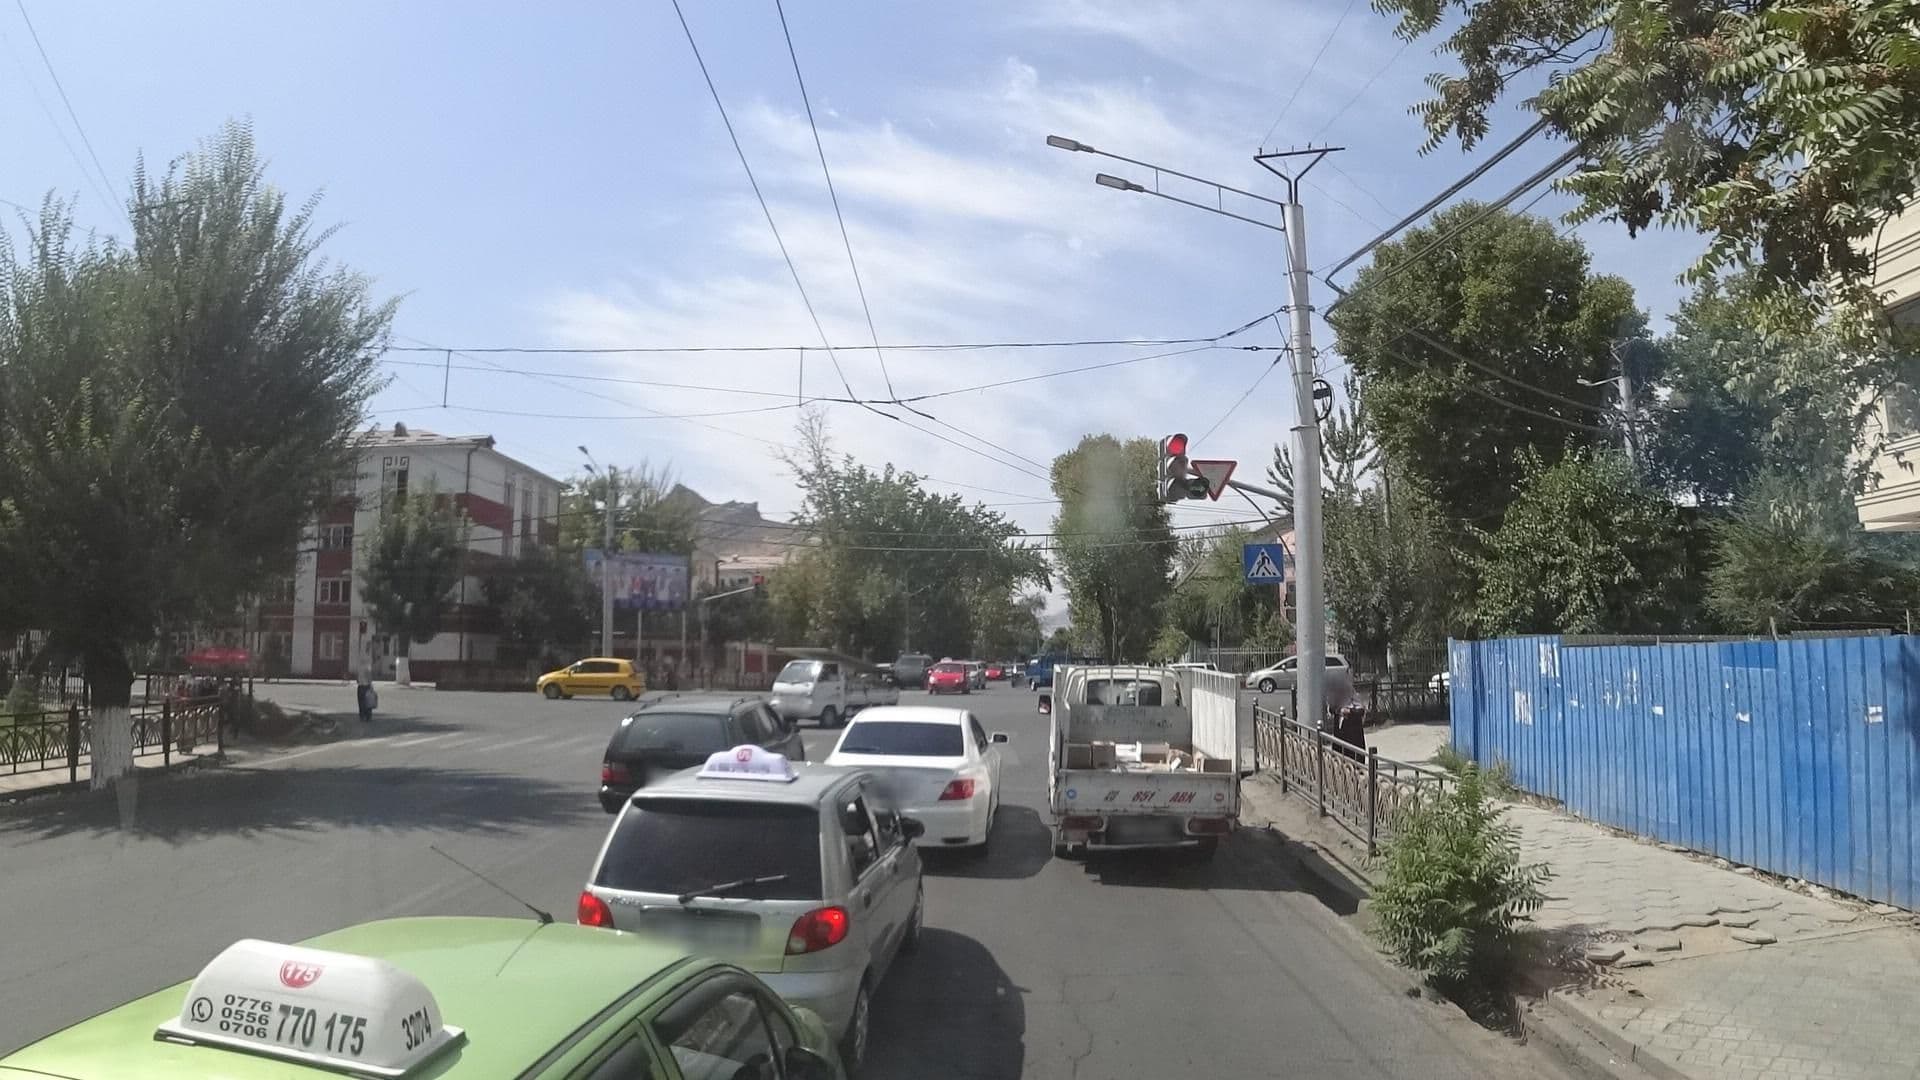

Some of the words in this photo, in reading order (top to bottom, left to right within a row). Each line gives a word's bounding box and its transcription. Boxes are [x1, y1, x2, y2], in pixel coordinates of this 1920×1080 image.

[285, 962, 318, 982] 175
[223, 993, 272, 1013] 0776
[221, 1006, 269, 1026] 0556
[219, 1020, 267, 1039] 0706
[276, 1003, 317, 1047] 770
[325, 1012, 367, 1056] 175
[401, 1005, 432, 1051] 3274
